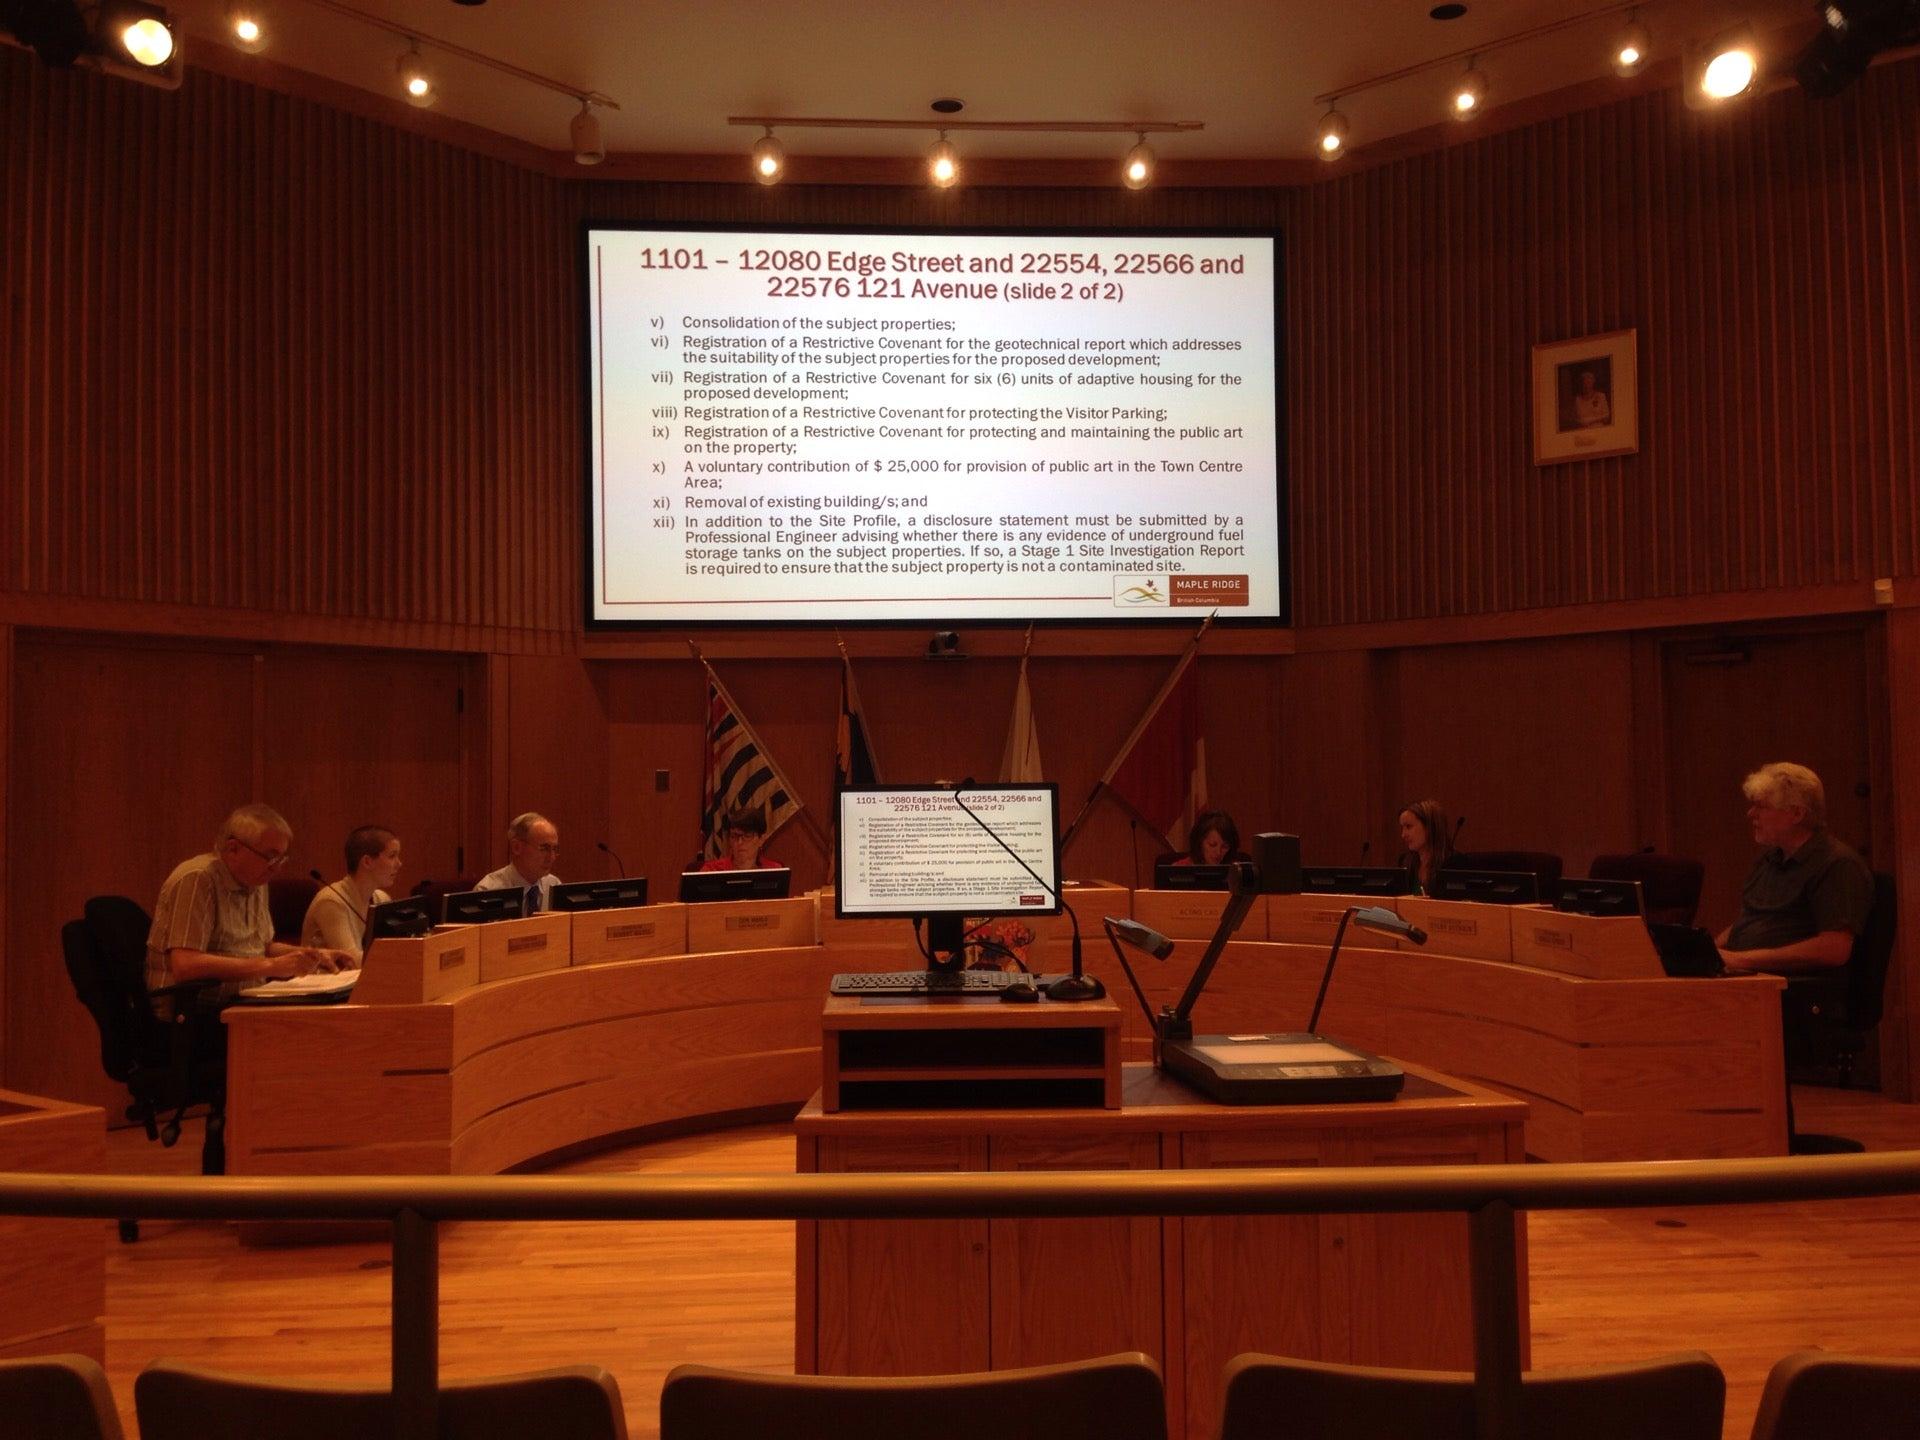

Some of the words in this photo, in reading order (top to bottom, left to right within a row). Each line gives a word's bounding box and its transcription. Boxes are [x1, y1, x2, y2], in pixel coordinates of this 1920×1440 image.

[640, 247, 708, 270] 1101
[739, 249, 821, 271] 12080
[827, 250, 886, 276] Edge
[891, 251, 964, 273] Street
[969, 252, 1013, 273] and
[1020, 252, 1107, 276] 22554,
[1113, 252, 1194, 274] 22566
[1199, 253, 1244, 275] and
[767, 276, 850, 298] 22576
[857, 277, 905, 298] 121
[910, 278, 997, 299] Avenue
[1003, 282, 1056, 302] (slide
[1060, 282, 1073, 299] 2
[1079, 282, 1099, 299] of
[1103, 282, 1123, 303] 2)
[650, 316, 664, 329] v)
[682, 315, 779, 328] Consolidation
[782, 316, 797, 329] of
[799, 317, 822, 329] the
[826, 317, 877, 331] subject
[881, 318, 955, 332] properties;
[650, 335, 668, 349] vi)
[683, 335, 766, 351] Registration
[771, 336, 785, 348] of
[789, 338, 797, 348] a
[802, 336, 874, 348] Restrictive
[878, 337, 942, 349] Covenant
[945, 337, 964, 349] for
[968, 338, 990, 349] the
[994, 337, 1079, 353] geotechnical
[1084, 338, 1126, 352] report
[1129, 338, 1167, 350] which
[1171, 338, 1241, 350] addresses
[651, 370, 673, 385] vii)
[683, 370, 767, 386] Registration
[773, 371, 787, 383] of
[791, 374, 800, 383] a
[806, 371, 876, 383] Restrictive
[882, 371, 945, 384] Covenant
[950, 372, 969, 384] for
[974, 372, 992, 384] six
[997, 372, 1015, 386] (6)
[1021, 372, 1053, 384] units
[1058, 372, 1072, 384] of
[1077, 372, 1134, 387] adaptive
[1140, 372, 1193, 387] housing
[1197, 372, 1216, 385] for
[1220, 373, 1242, 385] the
[651, 406, 677, 420] viii)
[684, 406, 769, 421] Registration
[772, 406, 786, 418] of
[789, 408, 797, 418] a
[803, 406, 875, 418] Restrictive
[879, 406, 944, 418] Covenant
[946, 406, 965, 418] for
[969, 407, 1038, 421] protecting
[1039, 407, 1062, 418] the
[1065, 407, 1109, 419] Visitor
[1112, 407, 1167, 422] Parking;
[652, 425, 669, 439] ix)
[684, 425, 767, 440] Registration
[772, 425, 786, 437] of
[790, 428, 798, 437] a
[804, 425, 874, 437] Restrictive
[879, 425, 942, 437] Covenant
[946, 425, 965, 437] for
[969, 426, 1037, 440] protecting
[1040, 426, 1065, 437] and
[1071, 426, 1150, 440] maintaining
[1152, 426, 1175, 438] the
[1179, 426, 1219, 440] public
[1223, 427, 1243, 438] art
[684, 443, 702, 453] on
[705, 441, 729, 453] the
[733, 441, 796, 455] property;
[652, 461, 665, 475] x)
[684, 460, 693, 472] A
[697, 460, 763, 474] voluntary
[767, 460, 849, 472] contribution
[855, 460, 869, 472] of
[874, 459, 882, 472] $
[888, 460, 938, 472] 25,000
[943, 460, 961, 472] for
[967, 460, 1026, 474] provision
[1031, 460, 1045, 472] of
[1049, 460, 1089, 474] public
[1093, 460, 1113, 472] art
[1117, 460, 1129, 471] in
[1133, 460, 1156, 472] the
[1160, 460, 1194, 472] Town
[1198, 460, 1243, 472] Centre
[684, 476, 722, 489] Area;
[653, 496, 670, 510] xi)
[685, 496, 746, 508] Removal
[749, 495, 764, 508] of
[767, 495, 821, 510] existing
[824, 495, 898, 509] building/s;
[901, 495, 927, 507] and
[653, 515, 674, 529] xii)
[685, 516, 698, 527] In
[705, 515, 762, 527] addition
[769, 515, 782, 527] to
[790, 515, 812, 527] the
[819, 514, 845, 526] Site
[853, 514, 900, 527] Profile,
[907, 517, 915, 526] a
[923, 514, 992, 526] disclosure
[999, 514, 1069, 526] statement
[1075, 514, 1109, 526] must
[1116, 514, 1132, 526] be
[1138, 513, 1207, 526] submitted
[1214, 513, 1229, 528] by
[1235, 516, 1243, 526] a
[685, 547, 737, 561] storage
[742, 546, 781, 558] tanks
[786, 548, 803, 558] on
[808, 546, 831, 558] the
[836, 545, 886, 559] subject
[892, 545, 964, 561] properties.
[970, 544, 979, 556] If
[983, 547, 1003, 558] so,
[1008, 547, 1016, 556] a
[1021, 544, 1060, 559] Stage
[1065, 544, 1074, 556] 1
[1079, 544, 1104, 556] Site
[1110, 544, 1194, 560] Investigation
[1200, 544, 1245, 558] Report
[1177, 580, 1209, 588] MAPLE
[1212, 580, 1240, 588] RIDGE
[886, 796, 911, 804] 12080
[912, 796, 931, 805] Edge
